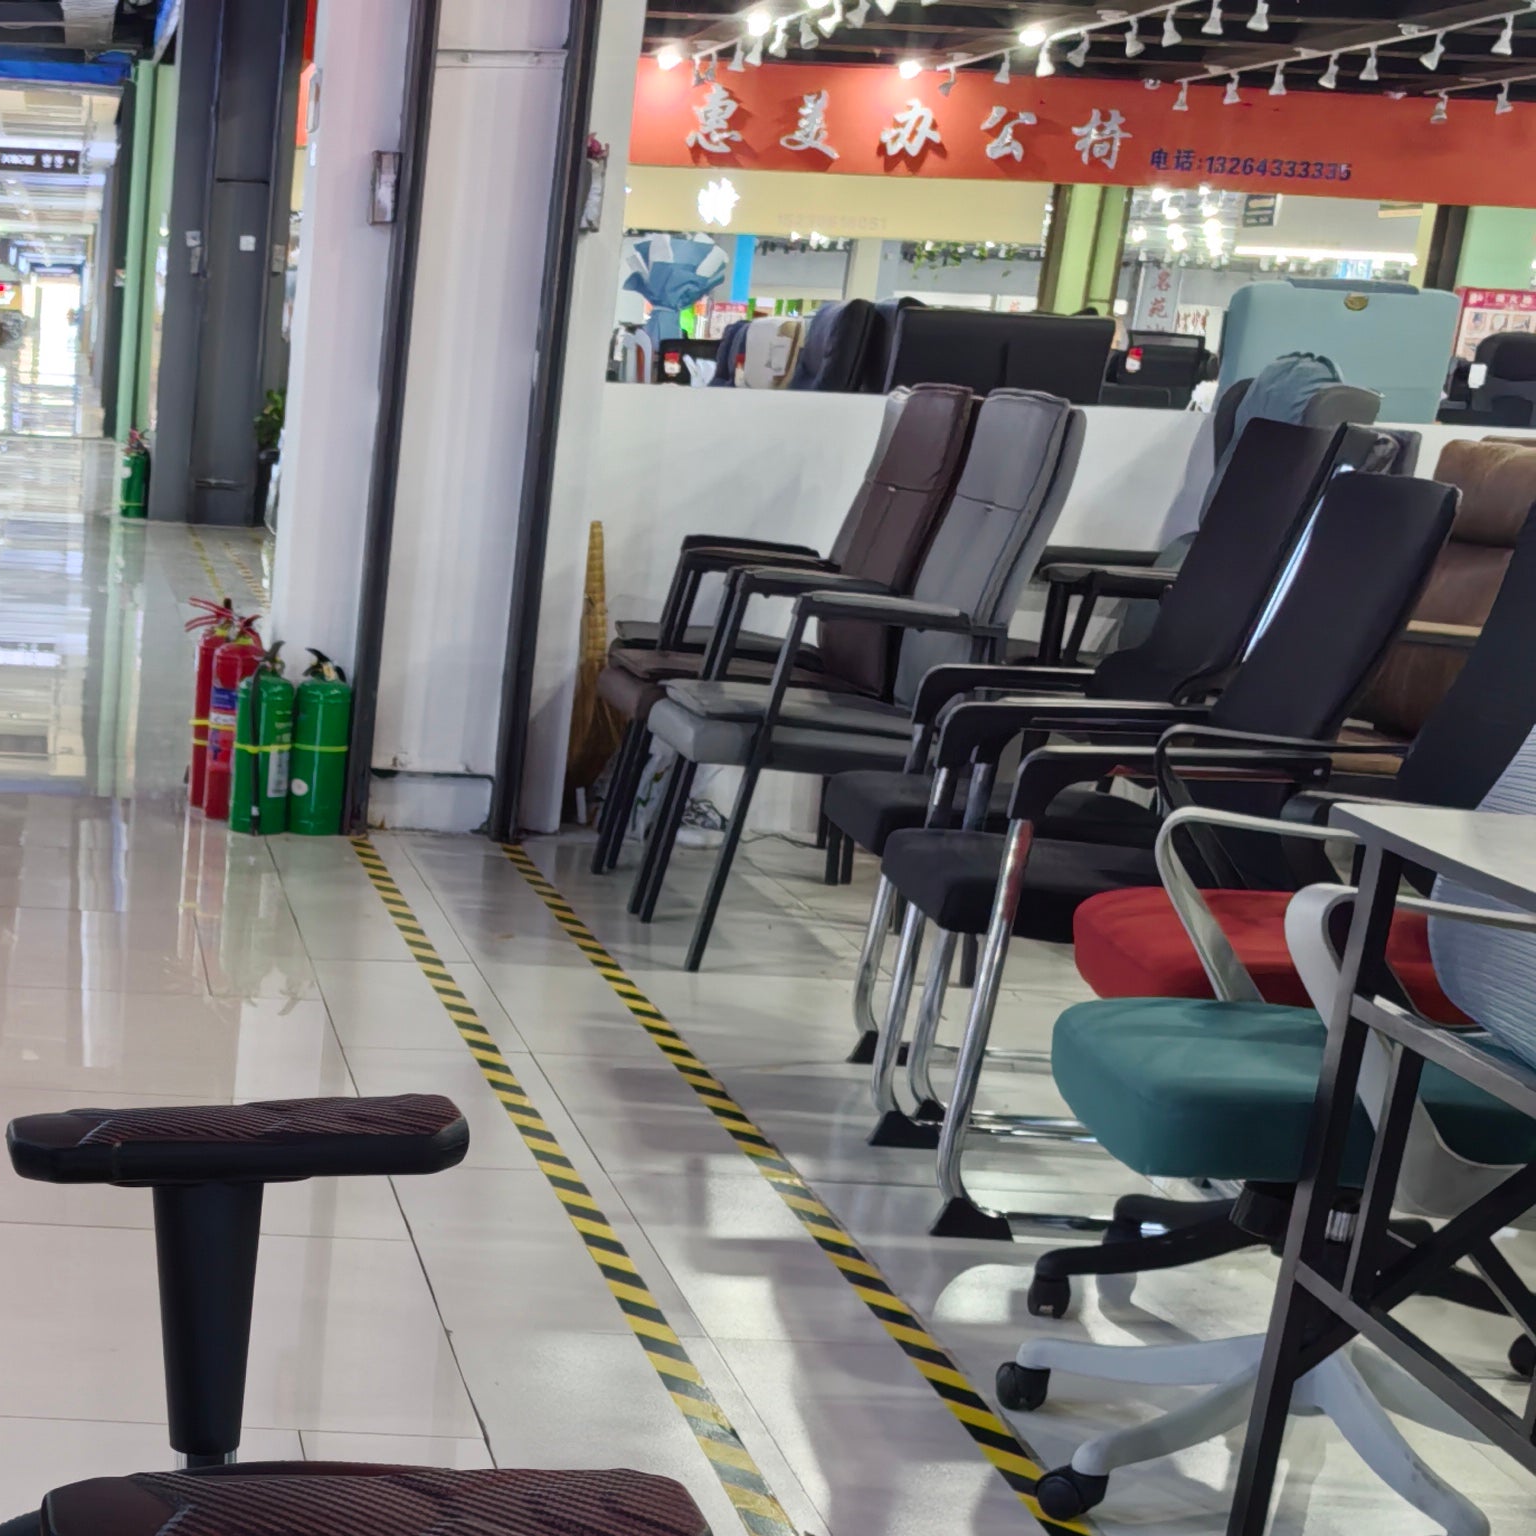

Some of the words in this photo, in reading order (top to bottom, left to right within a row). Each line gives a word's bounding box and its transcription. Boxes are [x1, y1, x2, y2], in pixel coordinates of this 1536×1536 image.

[686, 83, 1133, 170] 惠美办公椅
